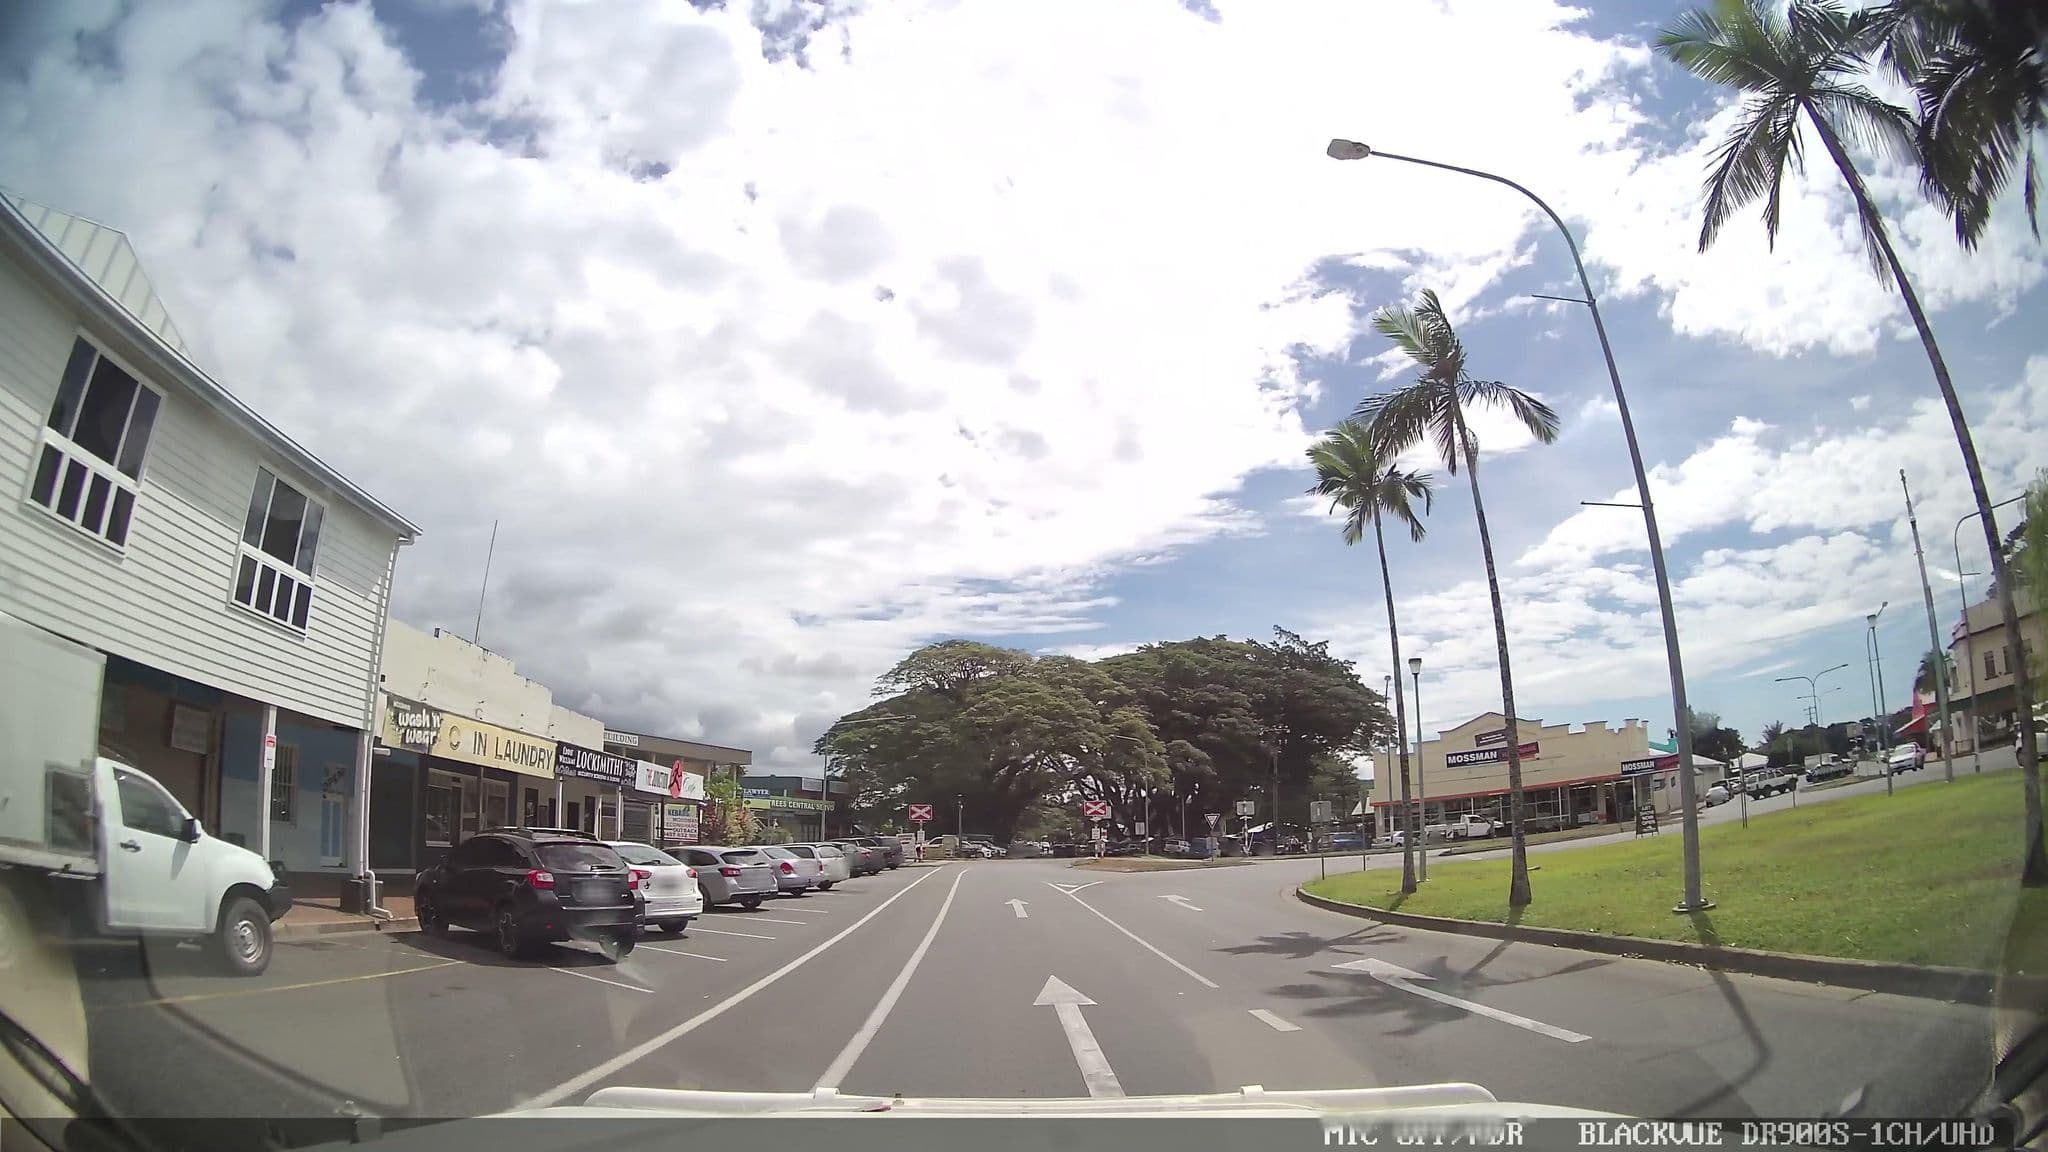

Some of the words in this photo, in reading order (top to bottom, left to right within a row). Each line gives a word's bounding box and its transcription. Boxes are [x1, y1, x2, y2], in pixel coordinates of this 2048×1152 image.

[398, 708, 430, 728] wash
[405, 728, 437, 745] wear
[494, 736, 553, 772] LAUNDRY
[1448, 751, 1498, 764] MOSSMAN
[1622, 760, 1655, 771] MOSSMAN
[788, 801, 815, 810] CENTRAL
